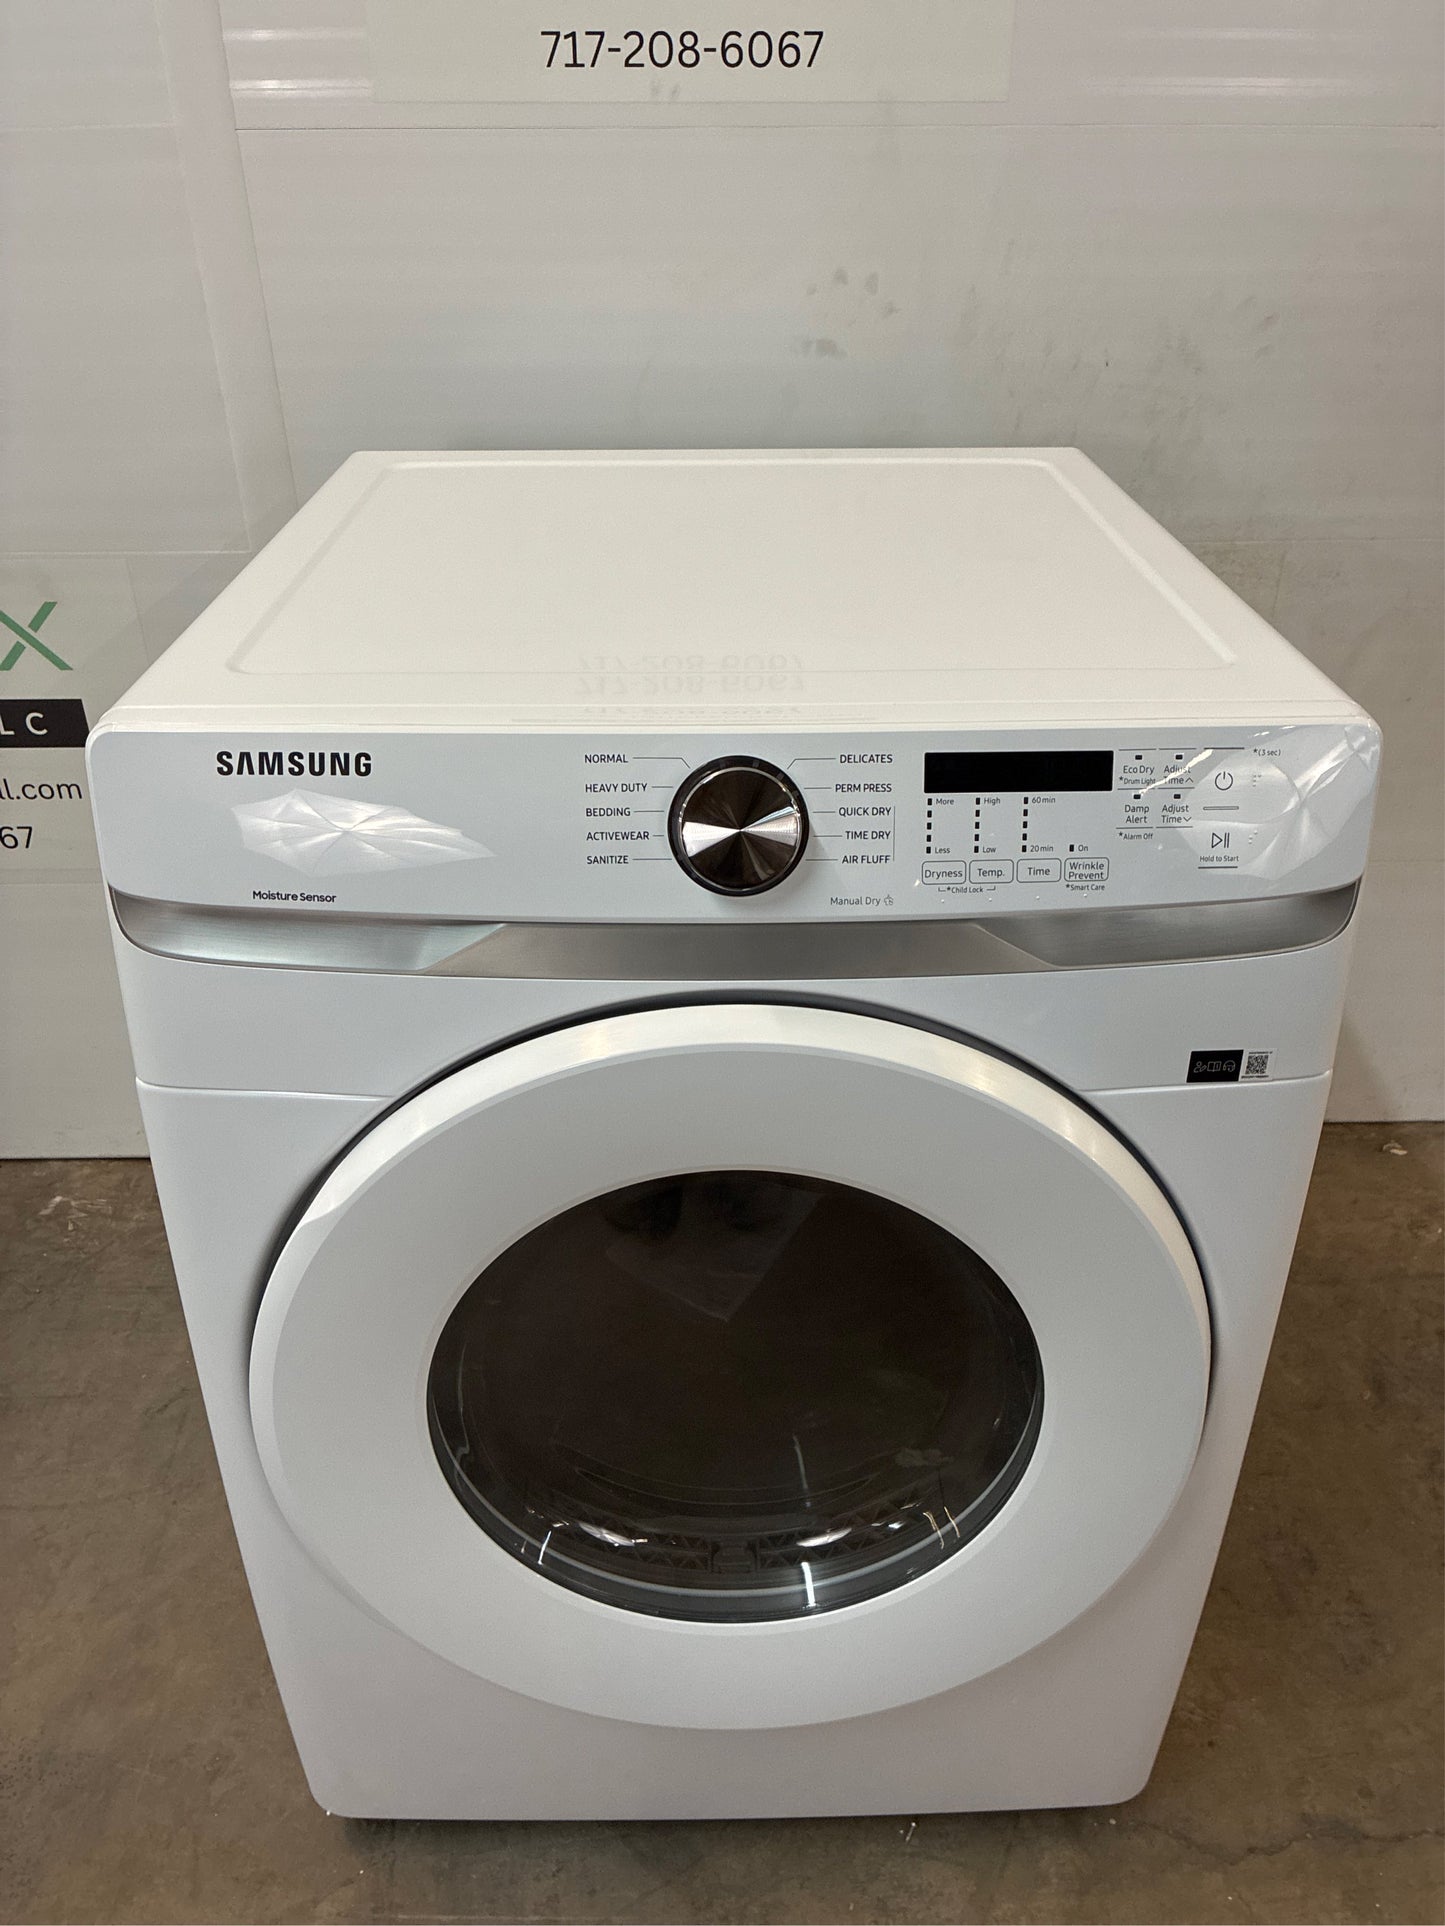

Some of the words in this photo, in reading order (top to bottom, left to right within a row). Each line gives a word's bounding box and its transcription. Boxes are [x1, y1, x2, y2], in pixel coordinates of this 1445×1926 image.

[541, 31, 823, 68] 717-208-6067
[585, 754, 628, 763] NORMAL
[840, 754, 892, 763] DELICATES
[217, 751, 371, 776] SAMSUNG
[1123, 765, 1138, 773] Eco
[1140, 765, 1154, 775] Dry
[0, 778, 83, 800] l.com
[586, 784, 618, 792] HEAVY
[621, 783, 647, 792] DUTY
[835, 784, 862, 793] PERM
[863, 784, 892, 793] PRESS
[936, 797, 954, 806] More
[984, 797, 1000, 806] High
[1032, 796, 1041, 804] 60
[1042, 795, 1055, 804] min
[586, 807, 630, 816] BEDDING
[839, 807, 869, 817] QUICK
[872, 807, 891, 816] DRY
[1125, 805, 1149, 814] Damp
[1162, 804, 1189, 815] Adjust
[1126, 815, 1147, 823] Alert
[1161, 815, 1182, 823] Time
[587, 831, 649, 840] ACTIVEWEAR
[846, 831, 868, 839] TIME
[871, 831, 891, 839] DRY
[935, 846, 950, 855] Less
[983, 846, 996, 854] Low
[1030, 844, 1039, 853] 20
[1078, 844, 1088, 853] On
[587, 855, 628, 864] SANITIZE
[842, 855, 858, 863] AIR
[861, 855, 890, 864] FLUFF
[1200, 855, 1214, 863] Hold
[1216, 855, 1222, 863] to
[1224, 854, 1239, 862] Start
[1070, 862, 1104, 870] Wrinkle
[925, 868, 963, 881] Dryness
[977, 868, 1006, 879] Temp.
[1028, 867, 1050, 875] Time
[1068, 871, 1104, 880] Prevent
[969, 885, 983, 894] Lock
[1091, 883, 1105, 891] Care
[253, 891, 298, 901] Moisture
[300, 893, 336, 902] Sensor
[831, 897, 862, 905] Manual
[866, 897, 881, 906] Dry
